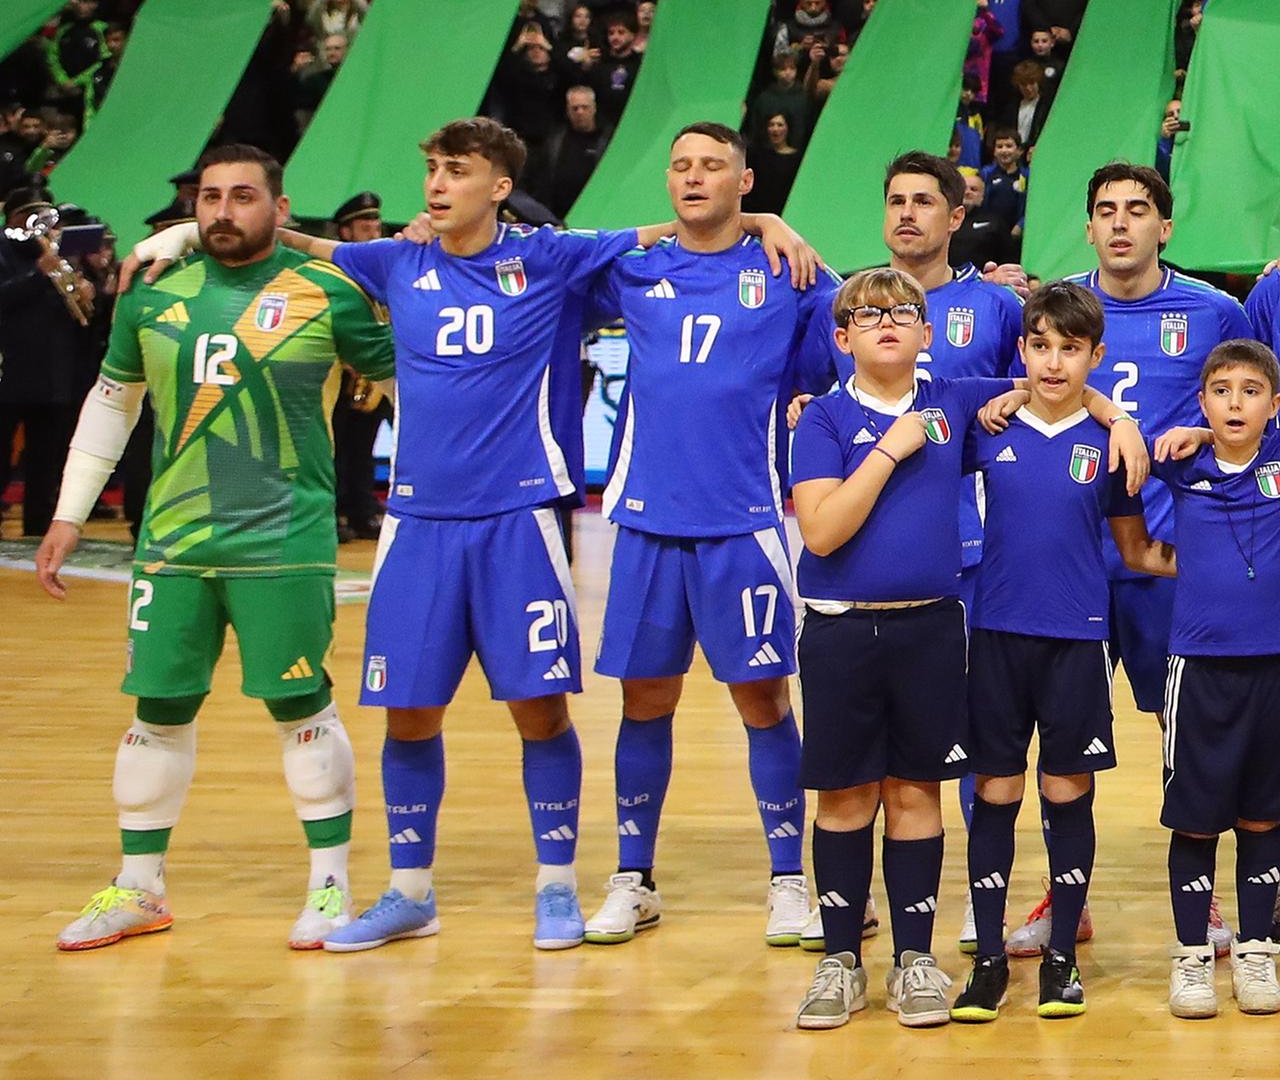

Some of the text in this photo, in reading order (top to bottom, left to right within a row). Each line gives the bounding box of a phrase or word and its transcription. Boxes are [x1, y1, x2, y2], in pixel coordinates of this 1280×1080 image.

[742, 275, 763, 283] ITALIA
[436, 304, 495, 356] 20
[680, 314, 722, 363] 17
[950, 315, 971, 323] ITALIA
[1163, 322, 1185, 331] ITALIA
[193, 333, 238, 385] 12
[1112, 361, 1139, 411] 2
[1075, 447, 1099, 460] ITALIA
[525, 599, 569, 653] 20
[741, 584, 779, 638] 17
